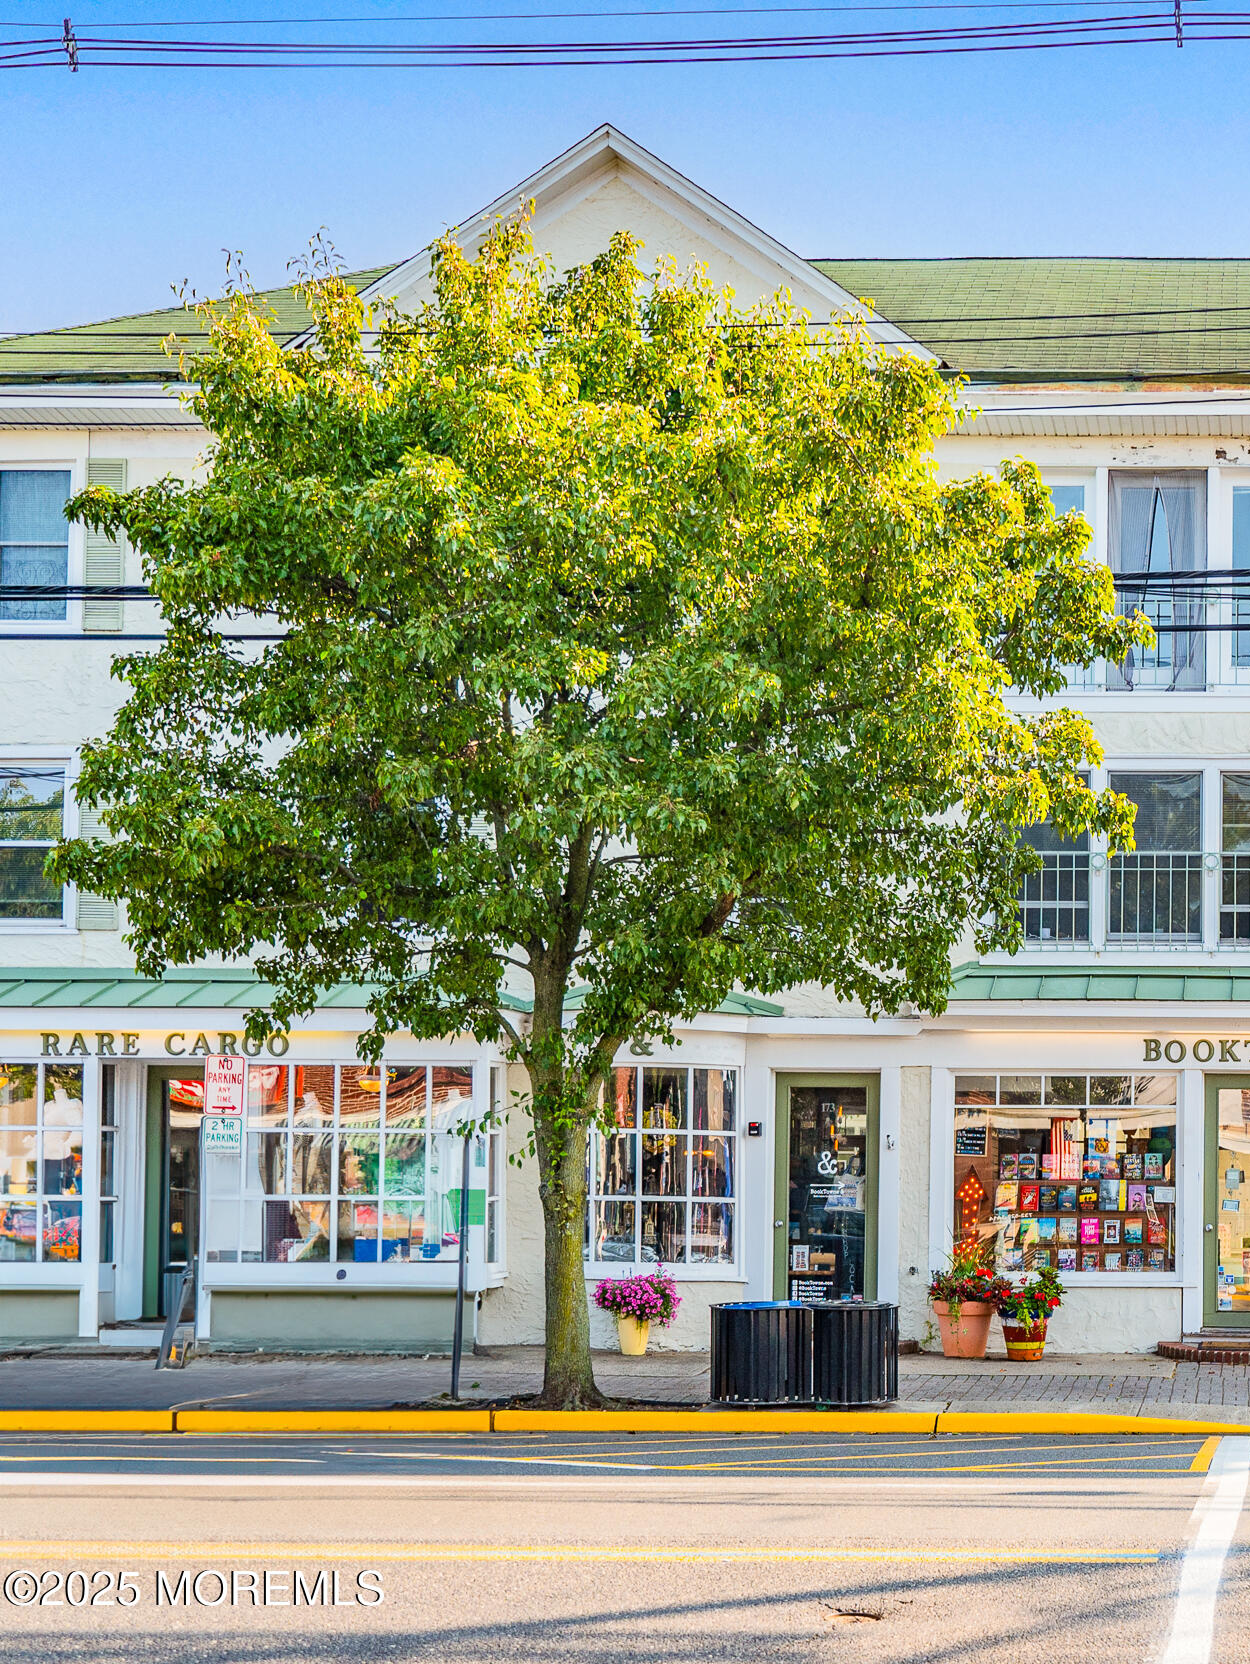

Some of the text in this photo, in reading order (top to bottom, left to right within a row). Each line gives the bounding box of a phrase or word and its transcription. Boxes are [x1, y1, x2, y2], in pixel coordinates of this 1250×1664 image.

[40, 1032, 290, 1057] RARE CARGO
[218, 1059, 233, 1070] NO
[208, 1072, 242, 1085] PARKING
[217, 1095, 232, 1103] TIME
[821, 1103, 836, 1113] 173
[211, 1121, 235, 1131] 2 HR
[205, 1133, 239, 1143] PARKING
[817, 1150, 838, 1175] &
